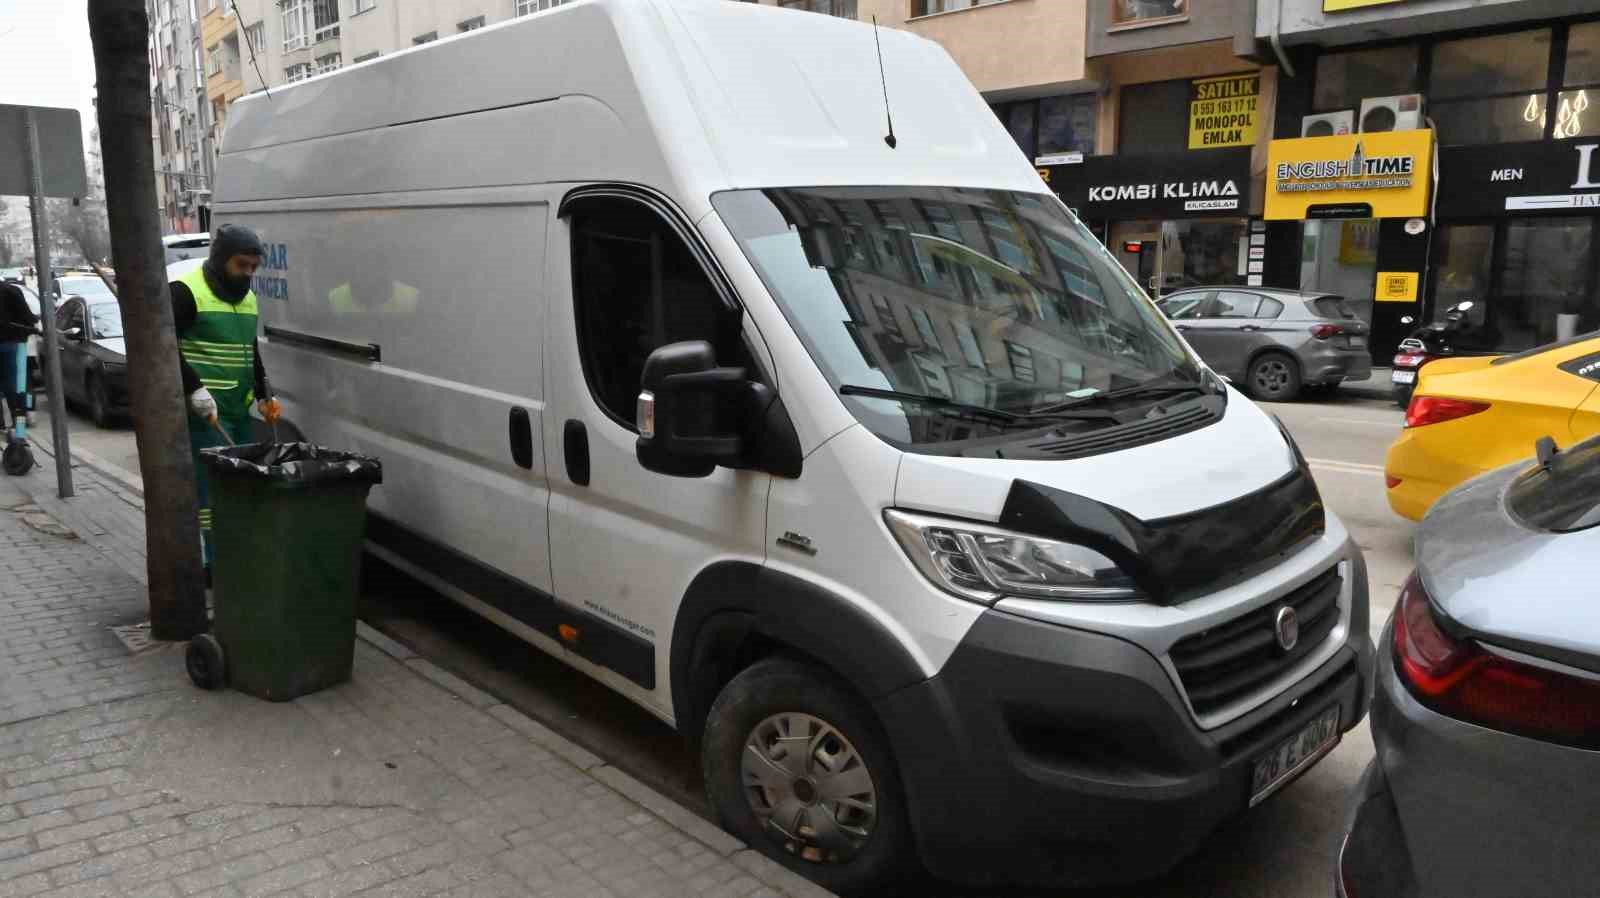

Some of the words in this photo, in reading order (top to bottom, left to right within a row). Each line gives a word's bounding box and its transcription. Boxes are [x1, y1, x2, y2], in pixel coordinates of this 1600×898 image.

[1195, 114, 1252, 130] MONOPOL
[1203, 130, 1242, 144] EMLAK
[1277, 160, 1349, 178] ENGLISH
[1365, 157, 1412, 174] TIME
[1490, 168, 1523, 182] MEN
